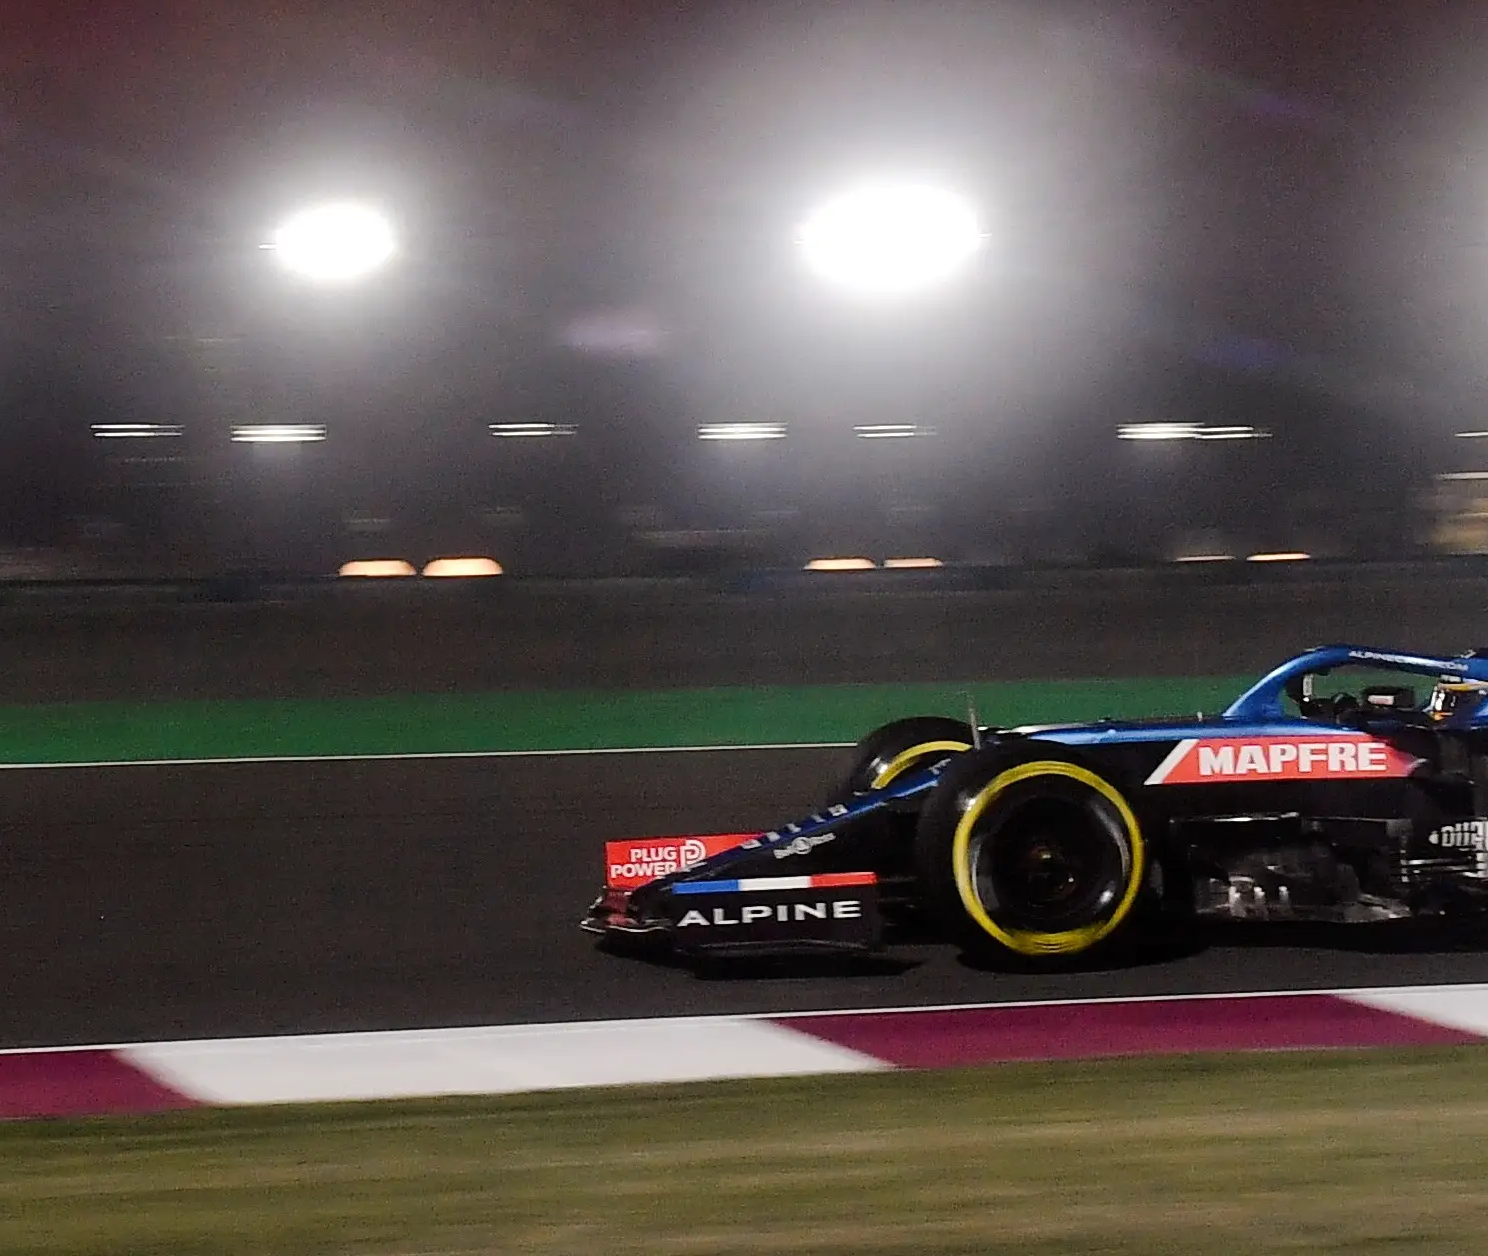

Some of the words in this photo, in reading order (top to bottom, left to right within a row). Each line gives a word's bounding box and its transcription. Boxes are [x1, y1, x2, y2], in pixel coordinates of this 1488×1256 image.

[1198, 742, 1388, 776] MAPFRE
[630, 846, 678, 862] PLUG
[610, 862, 678, 879] POWER
[676, 900, 862, 927] ALPINE
